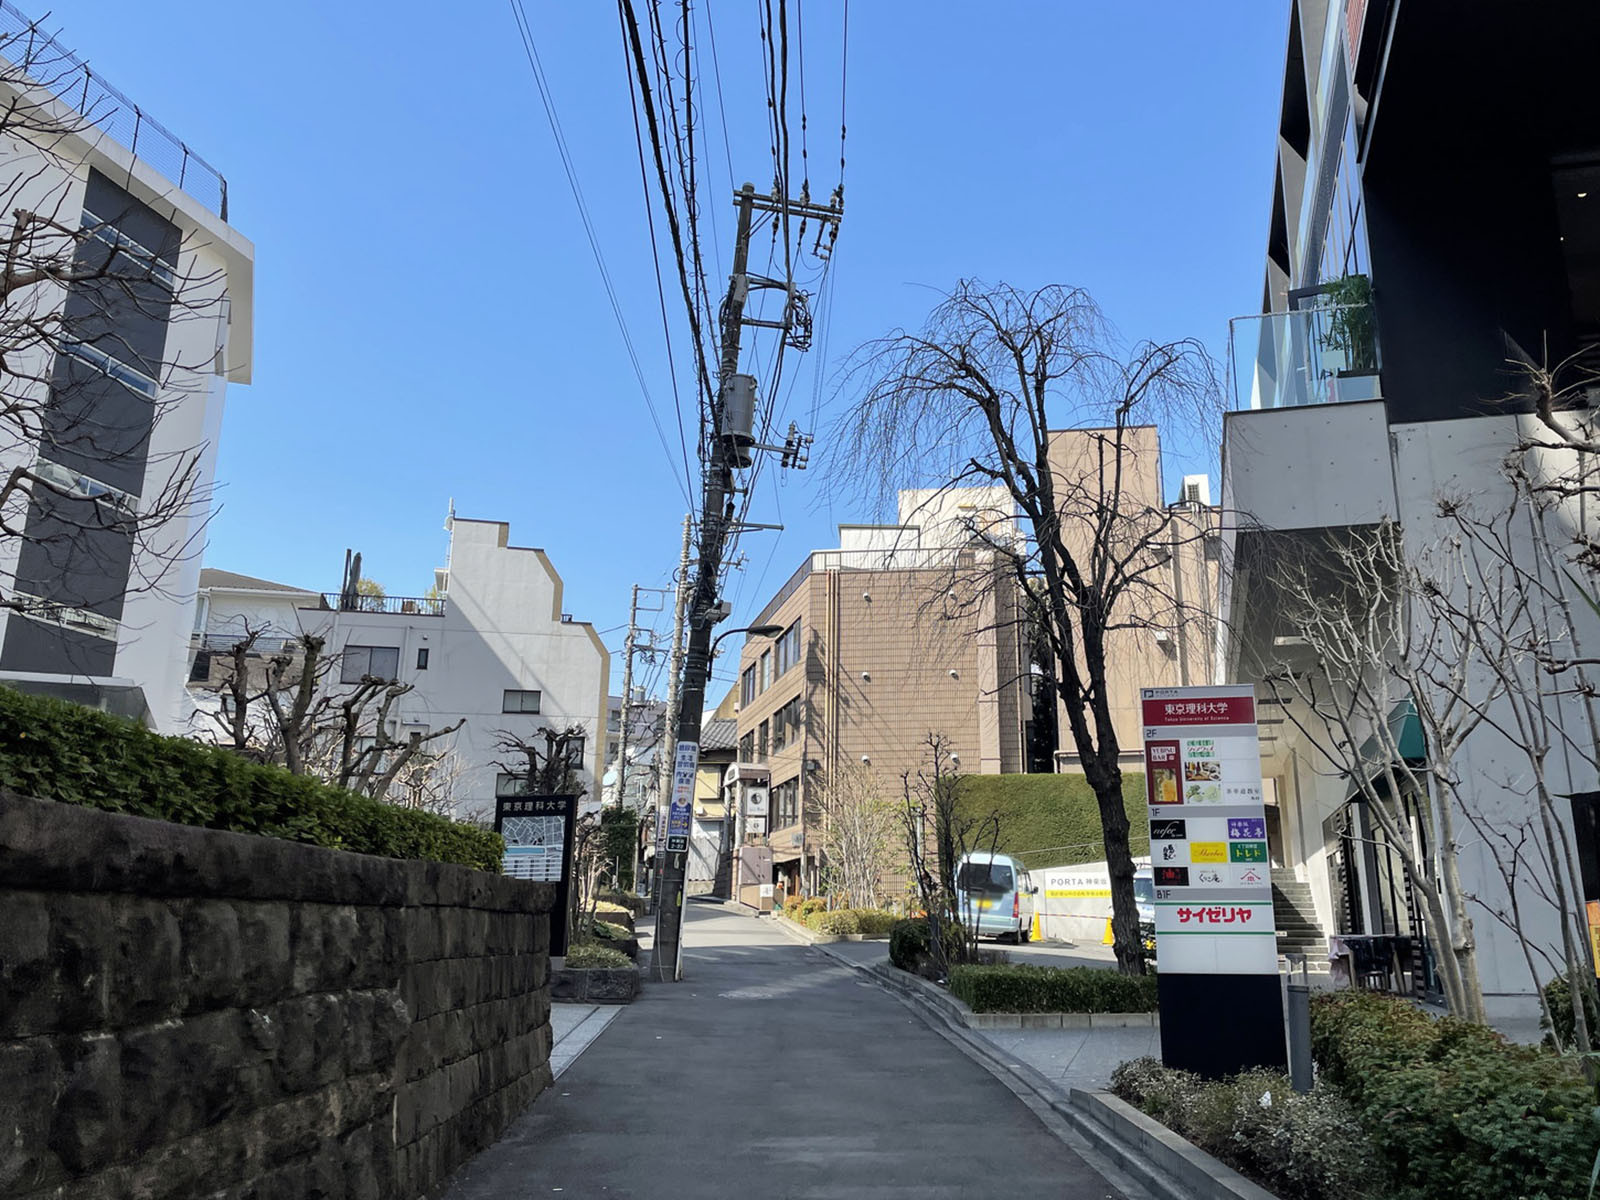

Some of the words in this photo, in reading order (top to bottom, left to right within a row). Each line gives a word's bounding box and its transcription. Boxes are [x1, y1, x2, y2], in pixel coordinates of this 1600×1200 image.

[1164, 702, 1228, 715] 東京理科大学
[1146, 729, 1157, 738] 2F
[503, 800, 567, 812] 東京理科大学
[1151, 808, 1160, 817] 1F
[1051, 878, 1084, 886] PORTA
[1156, 890, 1171, 899] B1F
[1177, 906, 1252, 923] サイゼリヤ
